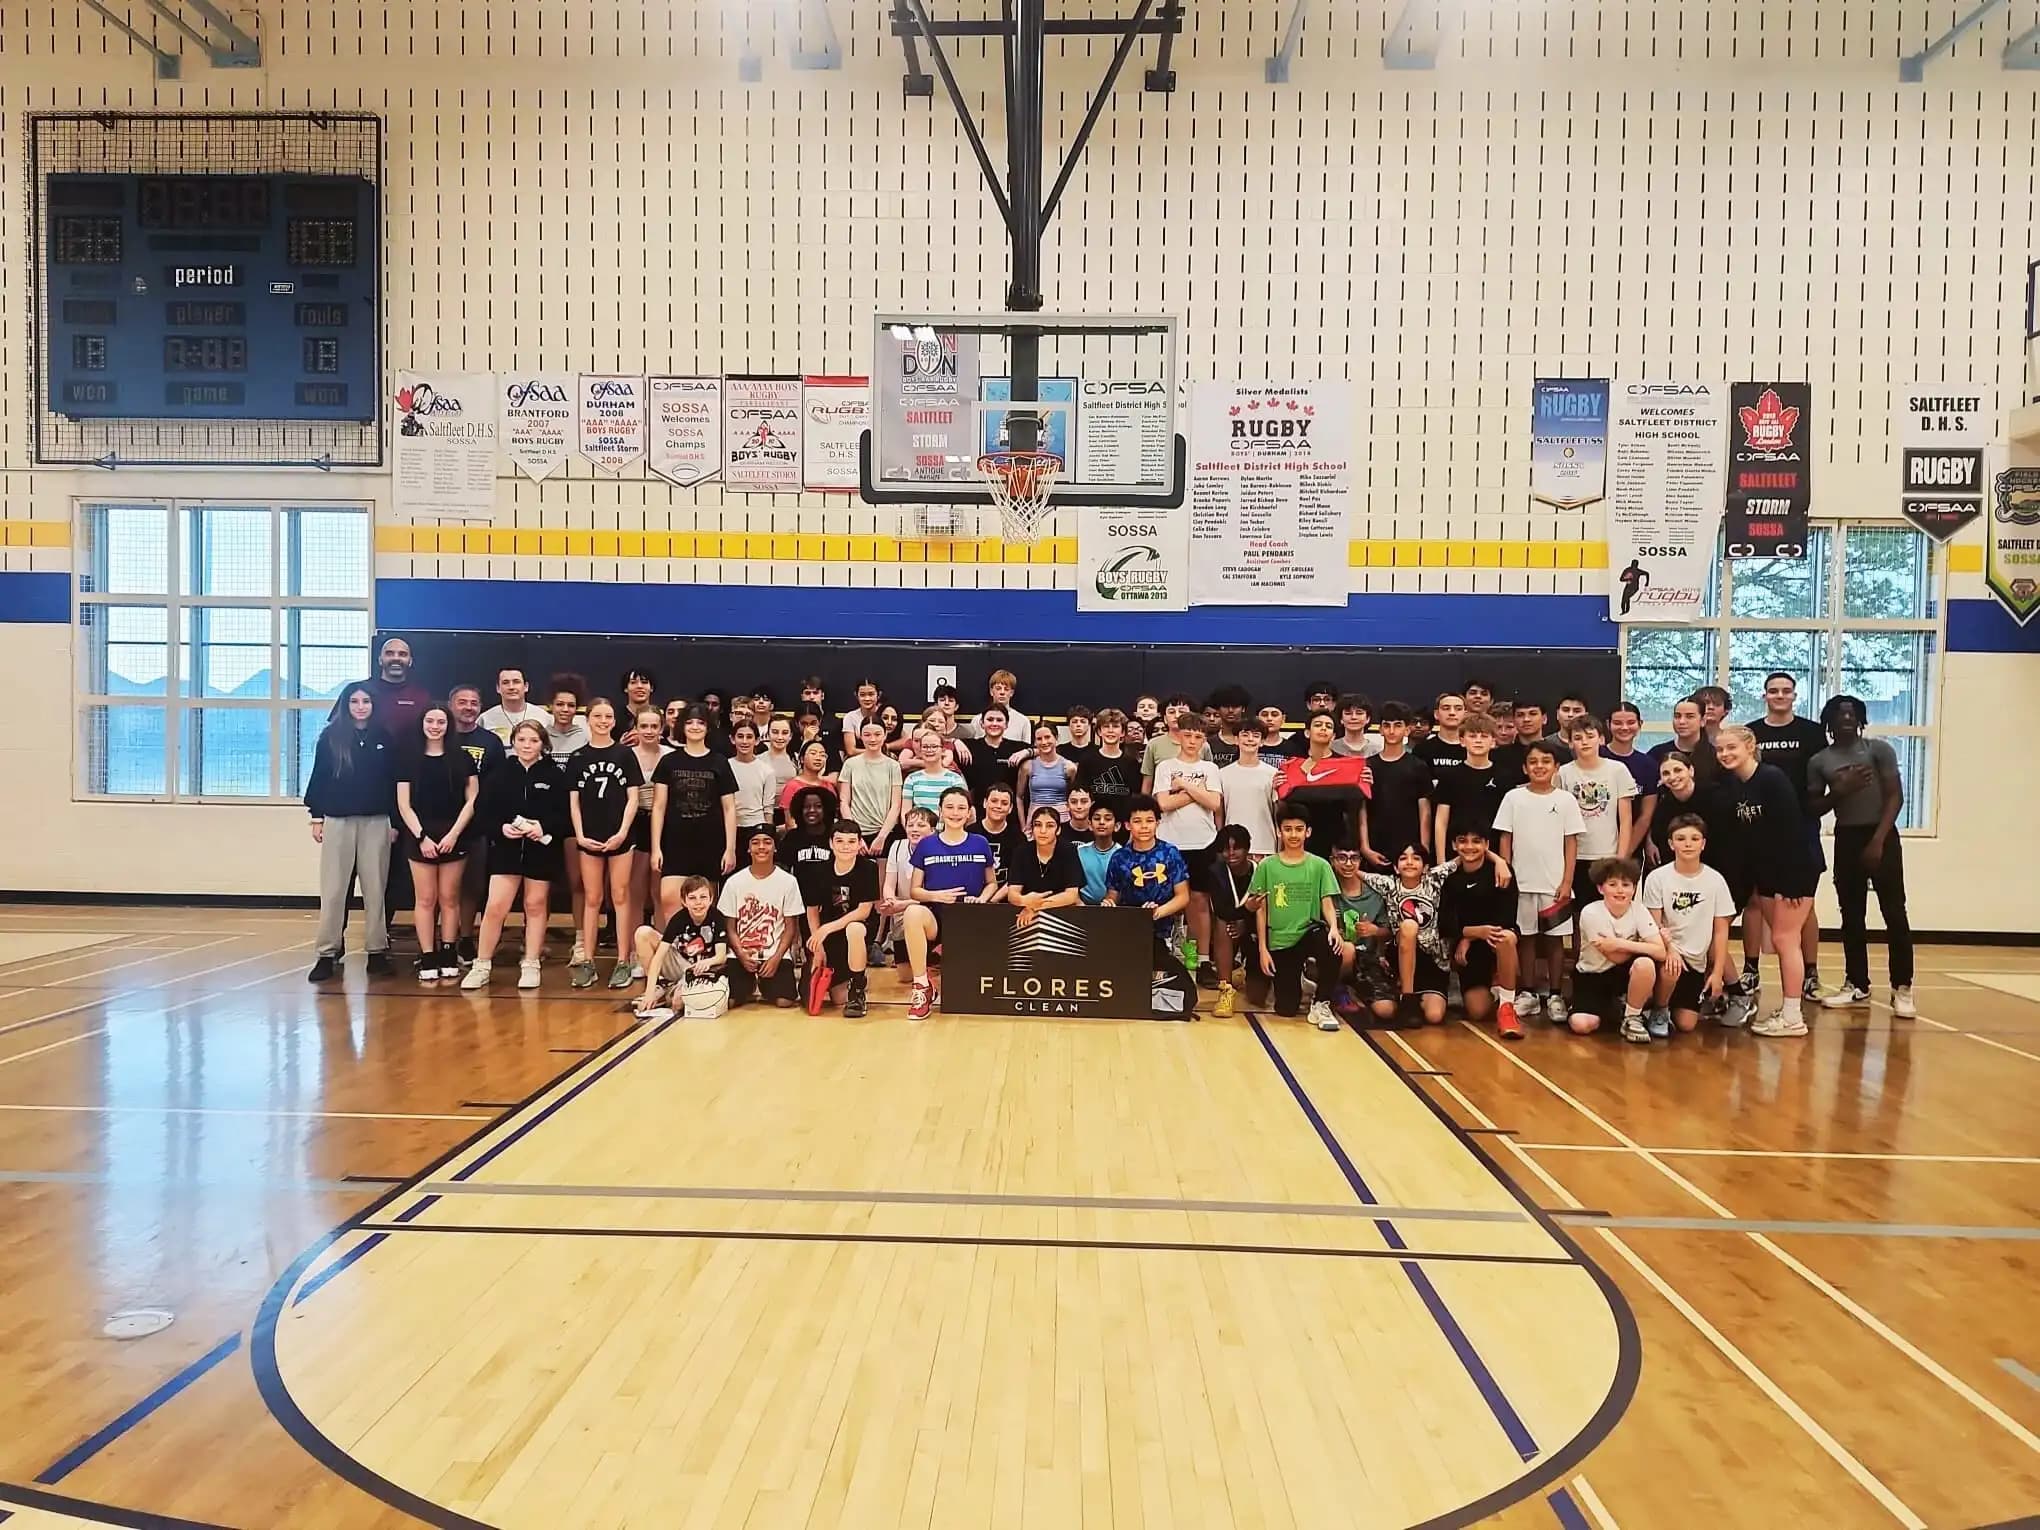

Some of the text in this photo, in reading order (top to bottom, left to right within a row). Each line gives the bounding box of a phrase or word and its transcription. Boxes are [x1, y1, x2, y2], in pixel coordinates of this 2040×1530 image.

[175, 265, 233, 287] period
[653, 382, 718, 391] OFSAA
[1627, 385, 1711, 396] OFSAA
[749, 391, 779, 399] RUGBY
[586, 401, 635, 409] DURHAM
[662, 403, 710, 413] SOSSA
[1144, 402, 1160, 411] High
[1540, 393, 1601, 418] RUGBY
[1910, 397, 1981, 412] SALTFLEET
[507, 409, 569, 418] BRANTFORD
[599, 409, 624, 417] 2008
[730, 409, 798, 420] OFSAA
[906, 411, 953, 424] SALTFLEET
[1640, 408, 1696, 416] WELCOMES
[527, 419, 550, 428] 2007
[661, 415, 710, 423] Welcomes
[1619, 419, 1718, 427] SALTFLEET DISTRICT
[608, 427, 636, 435] RUGBY
[668, 429, 704, 437] SOSSA
[1231, 419, 1311, 437] RUGBY
[1753, 425, 1785, 438] RUGBY
[1635, 431, 1701, 439] HIGH SCHOOL
[536, 437, 565, 445] RUGBY
[665, 439, 706, 449] Champs
[912, 434, 948, 448] STORM
[1230, 439, 1311, 449] OFSAA
[1536, 437, 1588, 446] SALTFLEET
[584, 444, 639, 452] Saltfleet Storm
[731, 450, 797, 462] BOYS' RUGBY
[916, 455, 945, 466] SOSSA
[1737, 452, 1800, 461] OFSAA
[915, 467, 945, 475] ANTIQUE
[1195, 461, 1347, 472] Saltfleet District High School
[1910, 456, 1976, 485] RUGBY
[771, 471, 796, 480] STORM
[1739, 472, 1798, 488] SALTFLEET
[1745, 499, 1791, 516] STORM
[1908, 503, 1976, 513] OFSAA
[1108, 525, 1158, 536] SOSSA
[1748, 522, 1784, 537] SOSSA
[1998, 539, 2034, 550] SALTFLEET
[1638, 546, 1688, 557] SOSSA
[1130, 571, 1168, 584] RUGBY
[1121, 592, 1168, 600] OTTAWA 2013
[1632, 590, 1700, 603] rugby
[578, 761, 627, 788] RAPTORS
[594, 776, 608, 798] 7
[797, 847, 831, 862] NEW YORK
[935, 854, 973, 864] BASKETBALL
[980, 976, 1114, 998] FLORES
[1014, 1001, 1079, 1012] CLEAN
